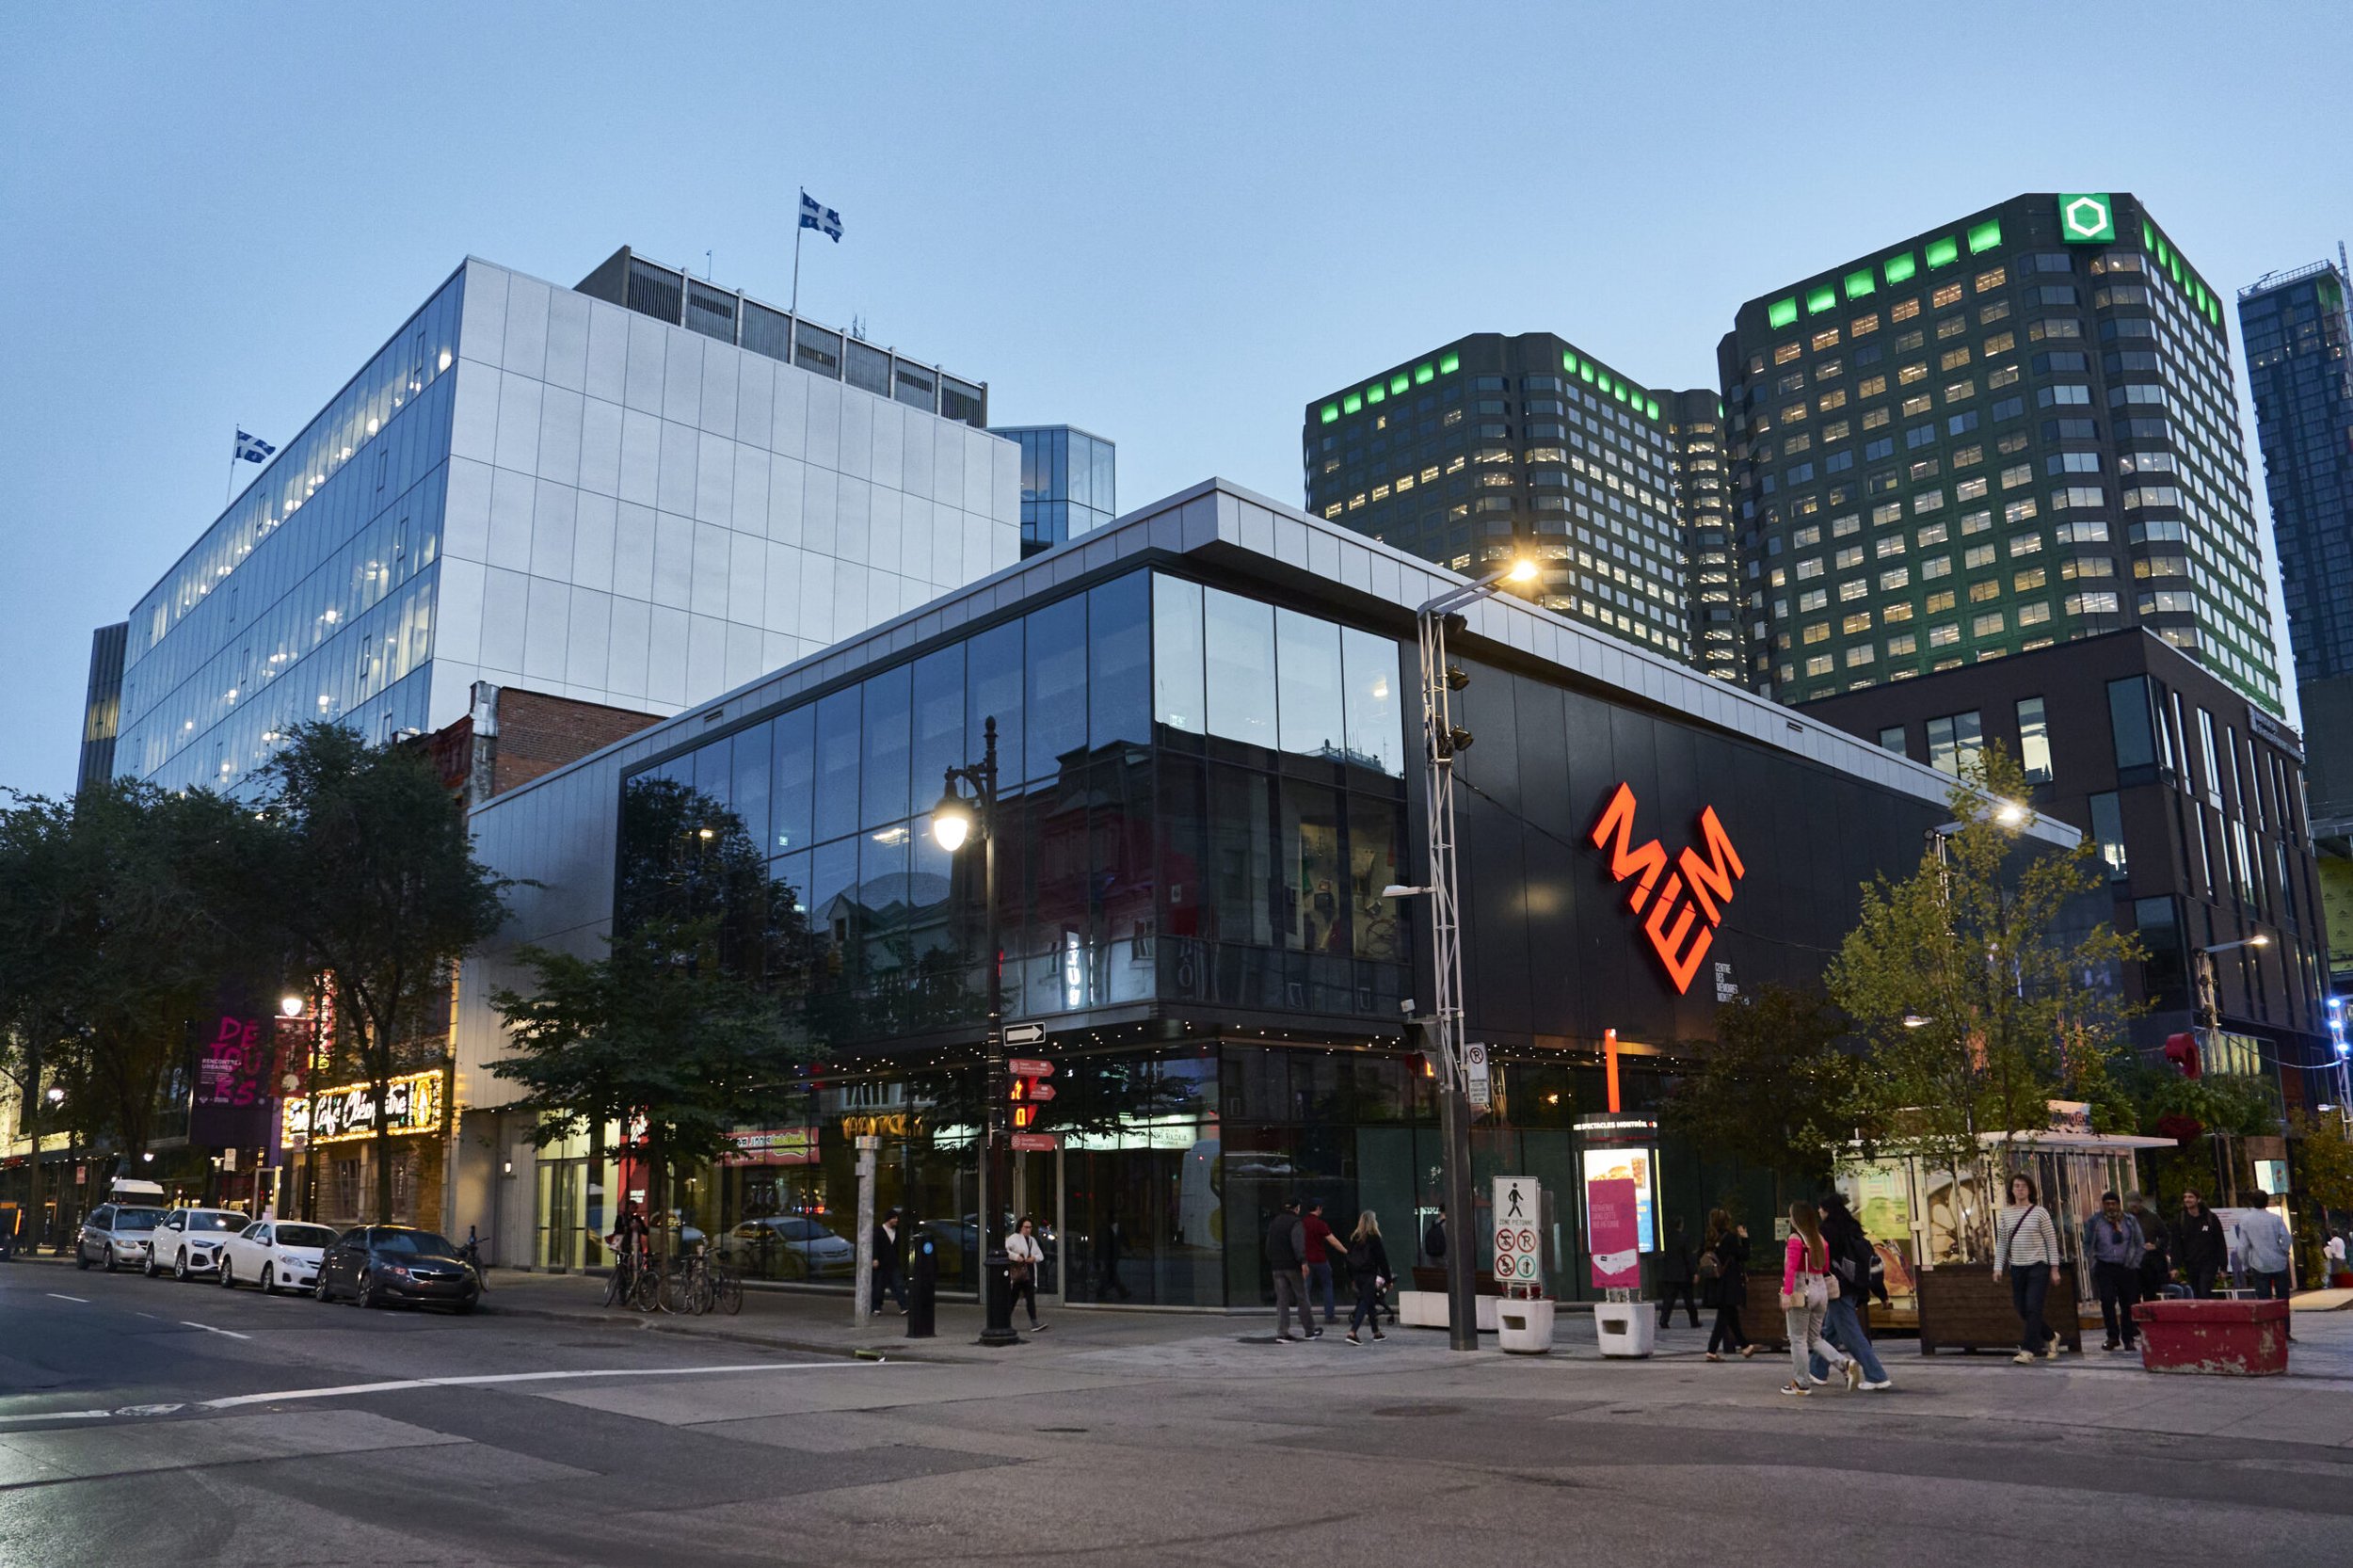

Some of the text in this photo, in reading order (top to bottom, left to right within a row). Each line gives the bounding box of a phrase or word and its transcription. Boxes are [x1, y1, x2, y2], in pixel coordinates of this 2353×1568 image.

[1715, 962, 1732, 974] CENTRE
[1716, 972, 1724, 983] DES
[1581, 1121, 1615, 1129] SPECTACLES
[1616, 1119, 1648, 1128] MONTRÉAL
